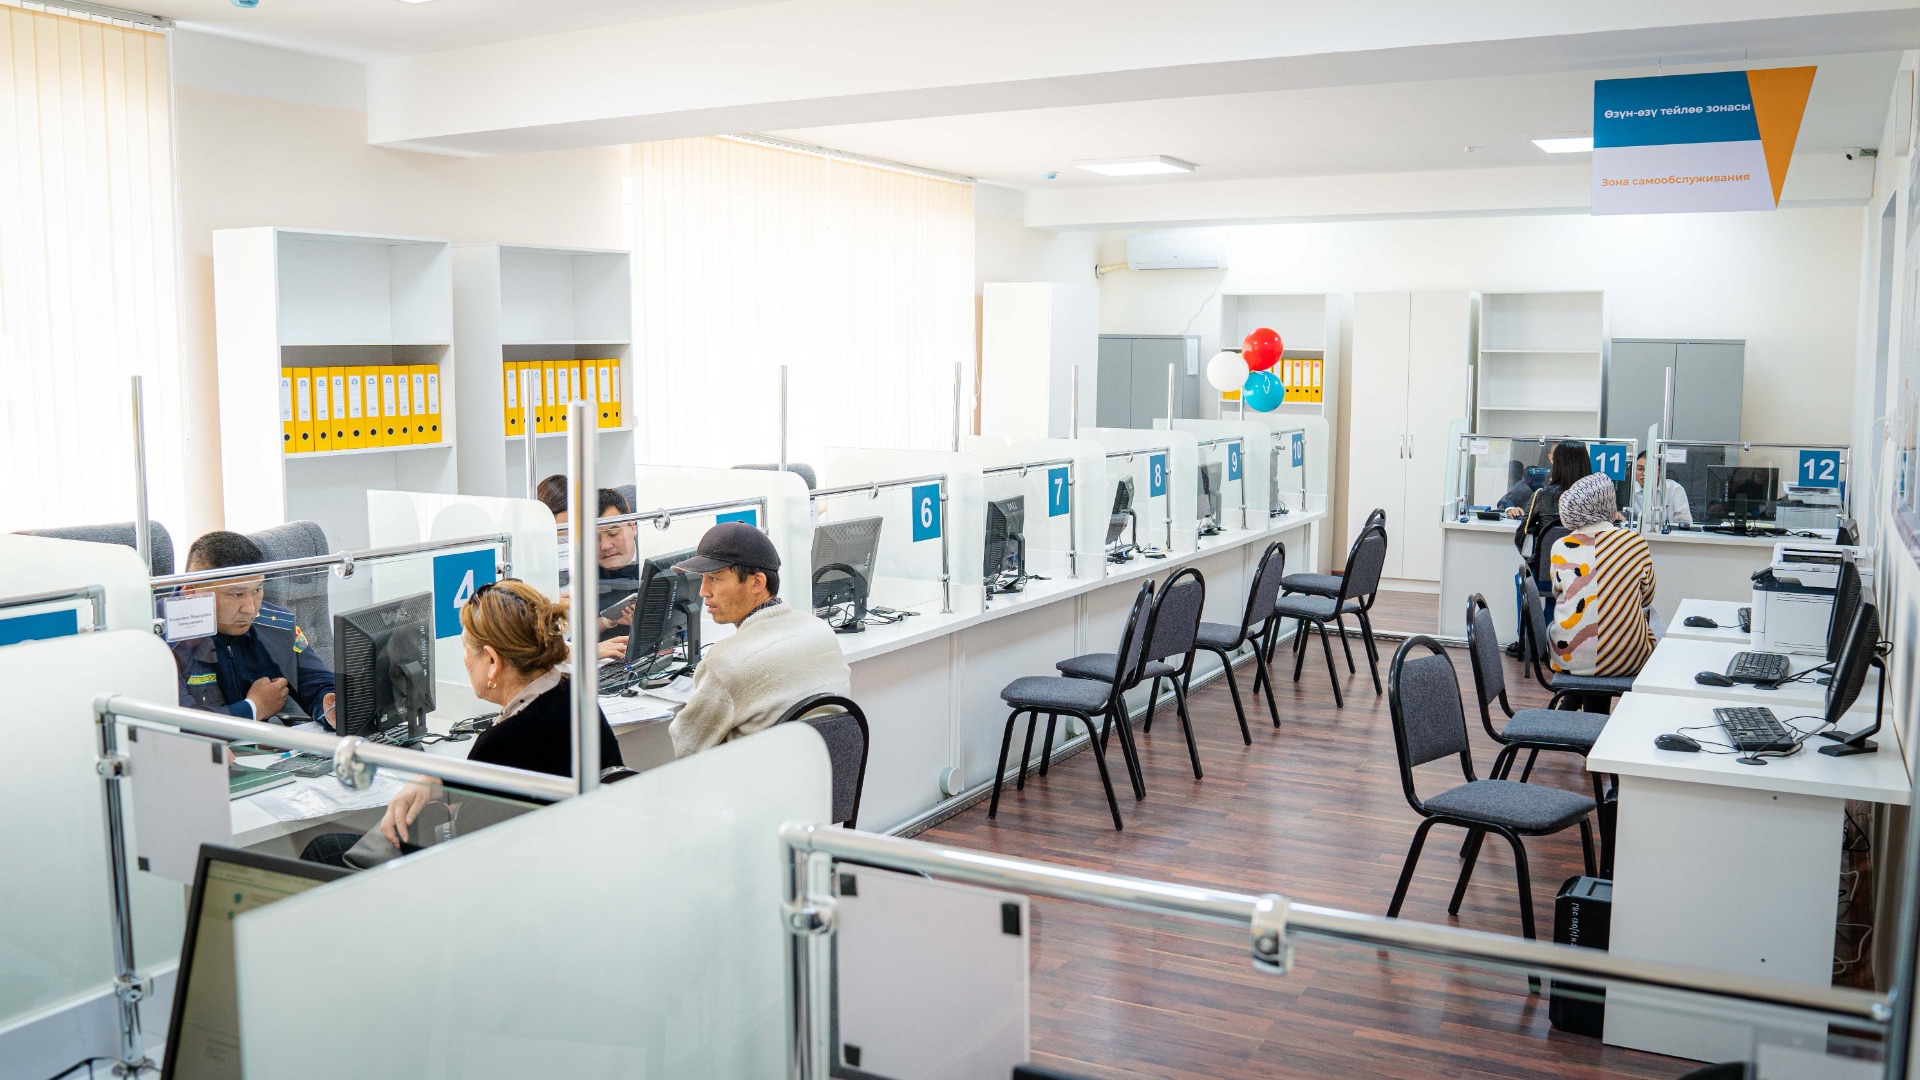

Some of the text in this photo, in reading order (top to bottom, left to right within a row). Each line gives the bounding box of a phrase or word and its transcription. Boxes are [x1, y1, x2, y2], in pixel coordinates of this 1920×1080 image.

[1604, 103, 1751, 119] Өзүн-өзү тейлөө зонасы
[1601, 173, 1750, 187] Зона самообслуживания
[1293, 440, 1302, 460] 10
[1231, 451, 1238, 473] 9
[1595, 452, 1620, 473] 11
[1803, 458, 1835, 480] 12
[1154, 463, 1162, 488] 8
[1054, 477, 1063, 506] 7
[920, 497, 933, 528] 6
[453, 569, 475, 609] 4
